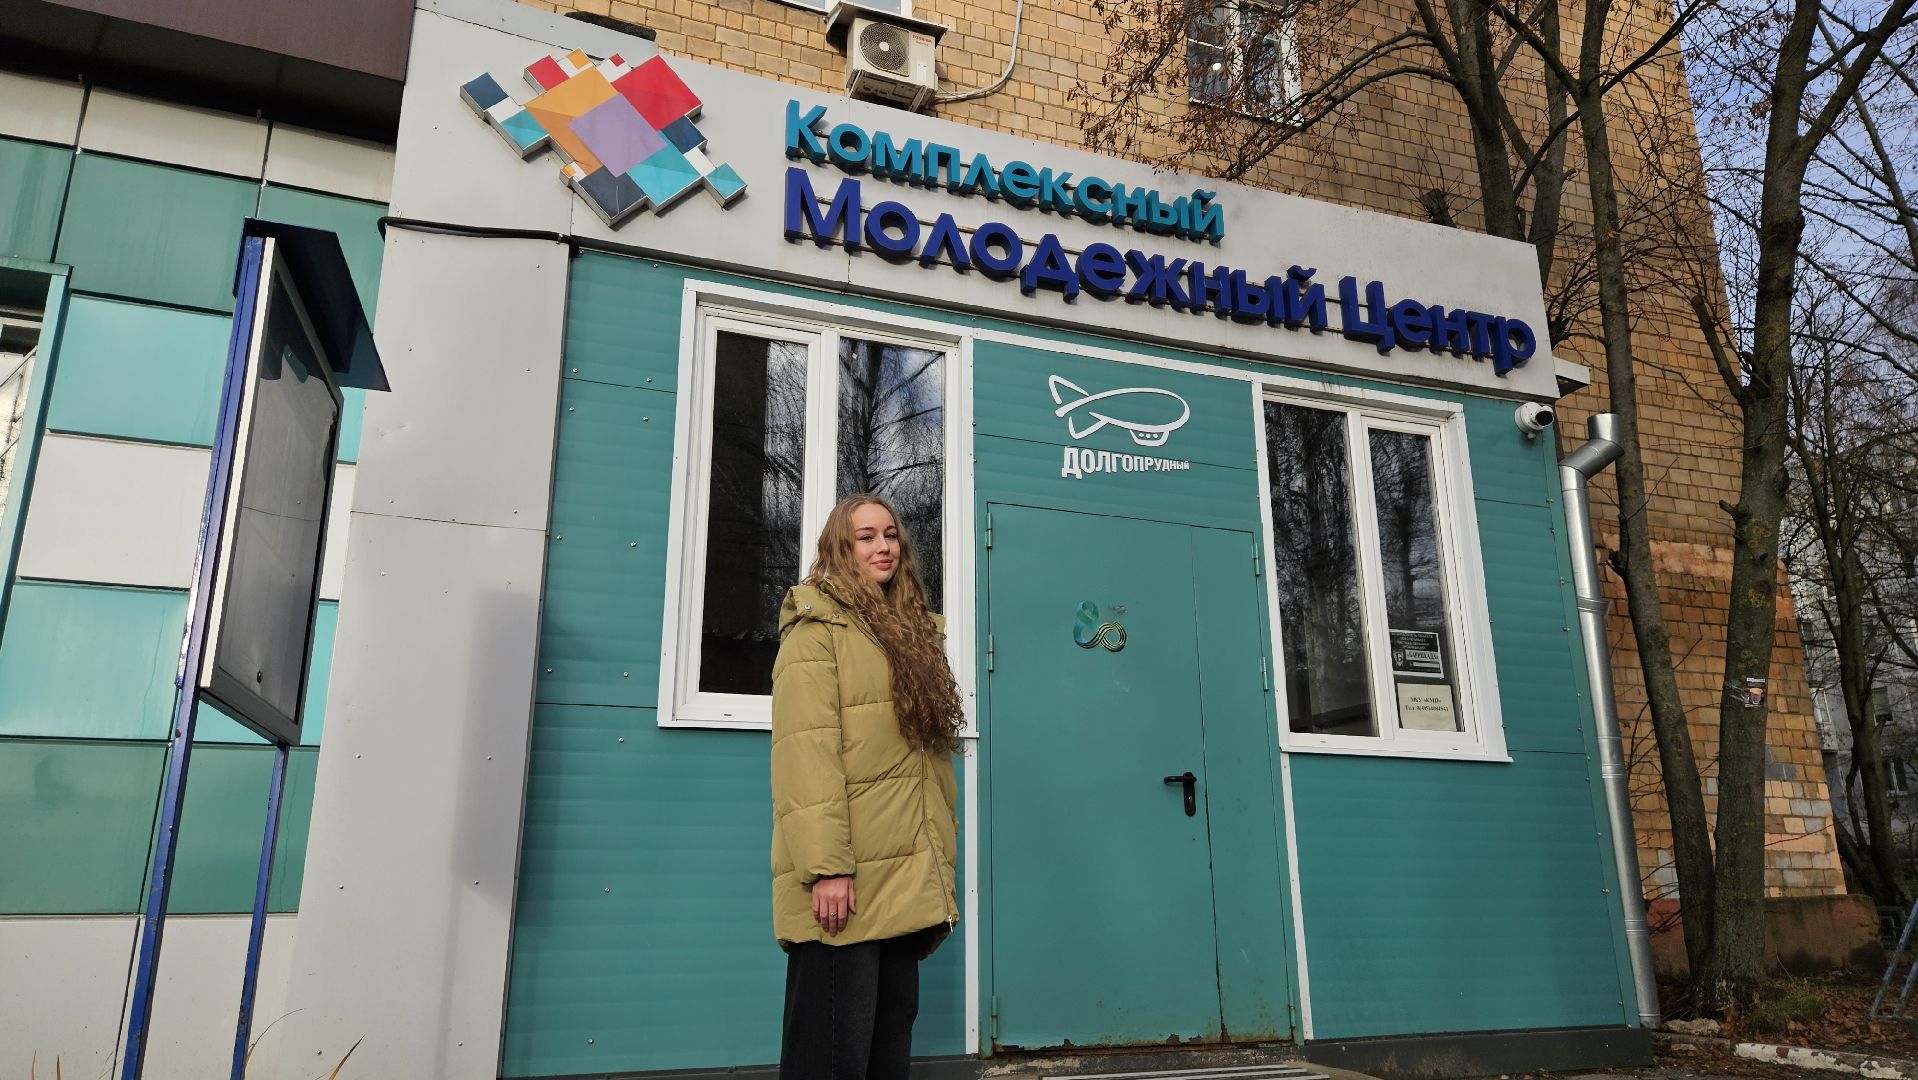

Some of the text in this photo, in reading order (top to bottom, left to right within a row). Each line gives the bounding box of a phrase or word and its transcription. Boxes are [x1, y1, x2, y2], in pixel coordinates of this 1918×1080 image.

[785, 99, 1225, 243] Комплексный
[784, 167, 1537, 376] Молодежный Центр
